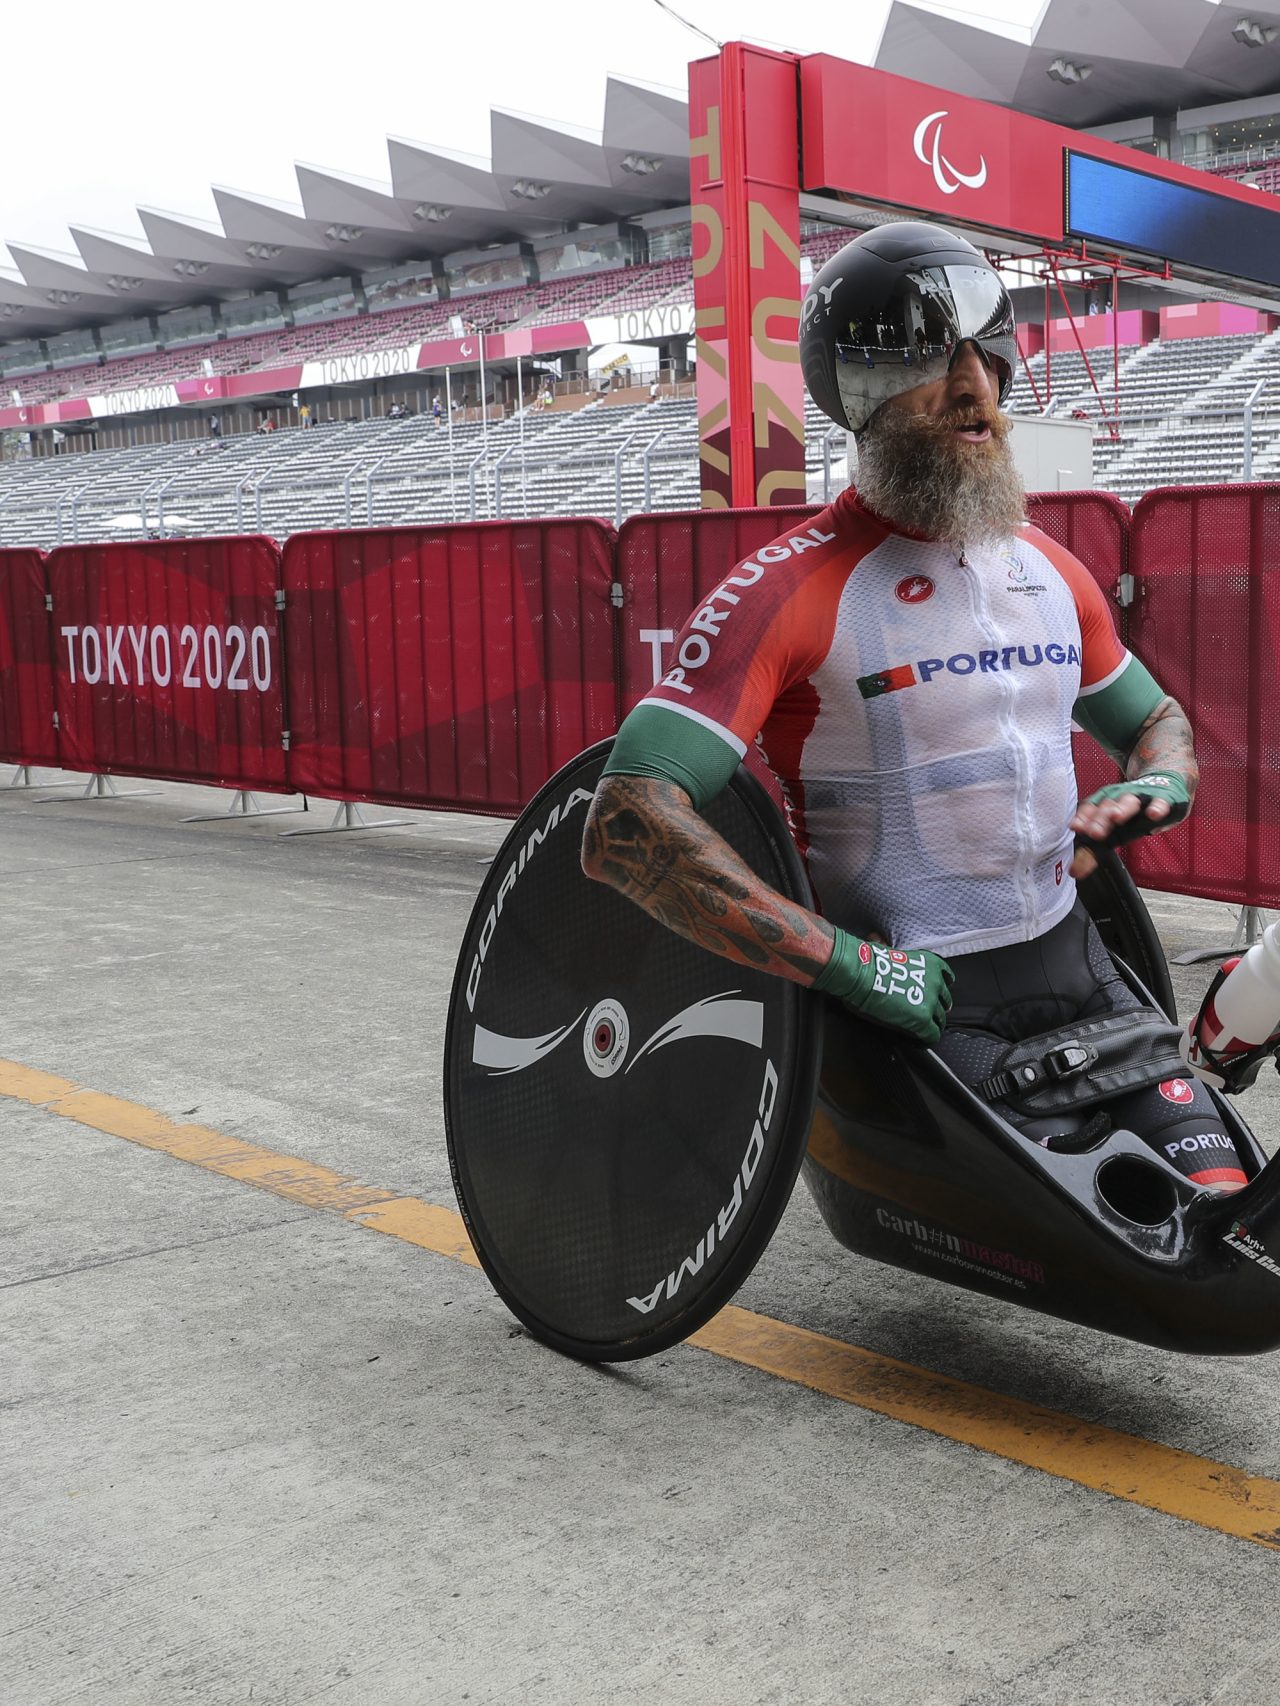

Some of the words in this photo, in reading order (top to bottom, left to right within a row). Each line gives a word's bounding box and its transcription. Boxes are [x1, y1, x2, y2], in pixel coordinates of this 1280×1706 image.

[614, 304, 683, 342] TOKYO
[319, 353, 370, 385] TOKYO
[373, 348, 411, 378] 2020
[103, 388, 142, 416] TOKYO
[144, 385, 173, 409] 2020
[660, 526, 838, 695] PORTUGAL
[60, 624, 172, 687] TOKYO
[180, 624, 271, 692] 2020
[916, 642, 1082, 683] PORTUGA
[465, 787, 597, 1014] CORIMA
[906, 954, 926, 1006] GAL
[625, 1058, 779, 1315] CORIMA
